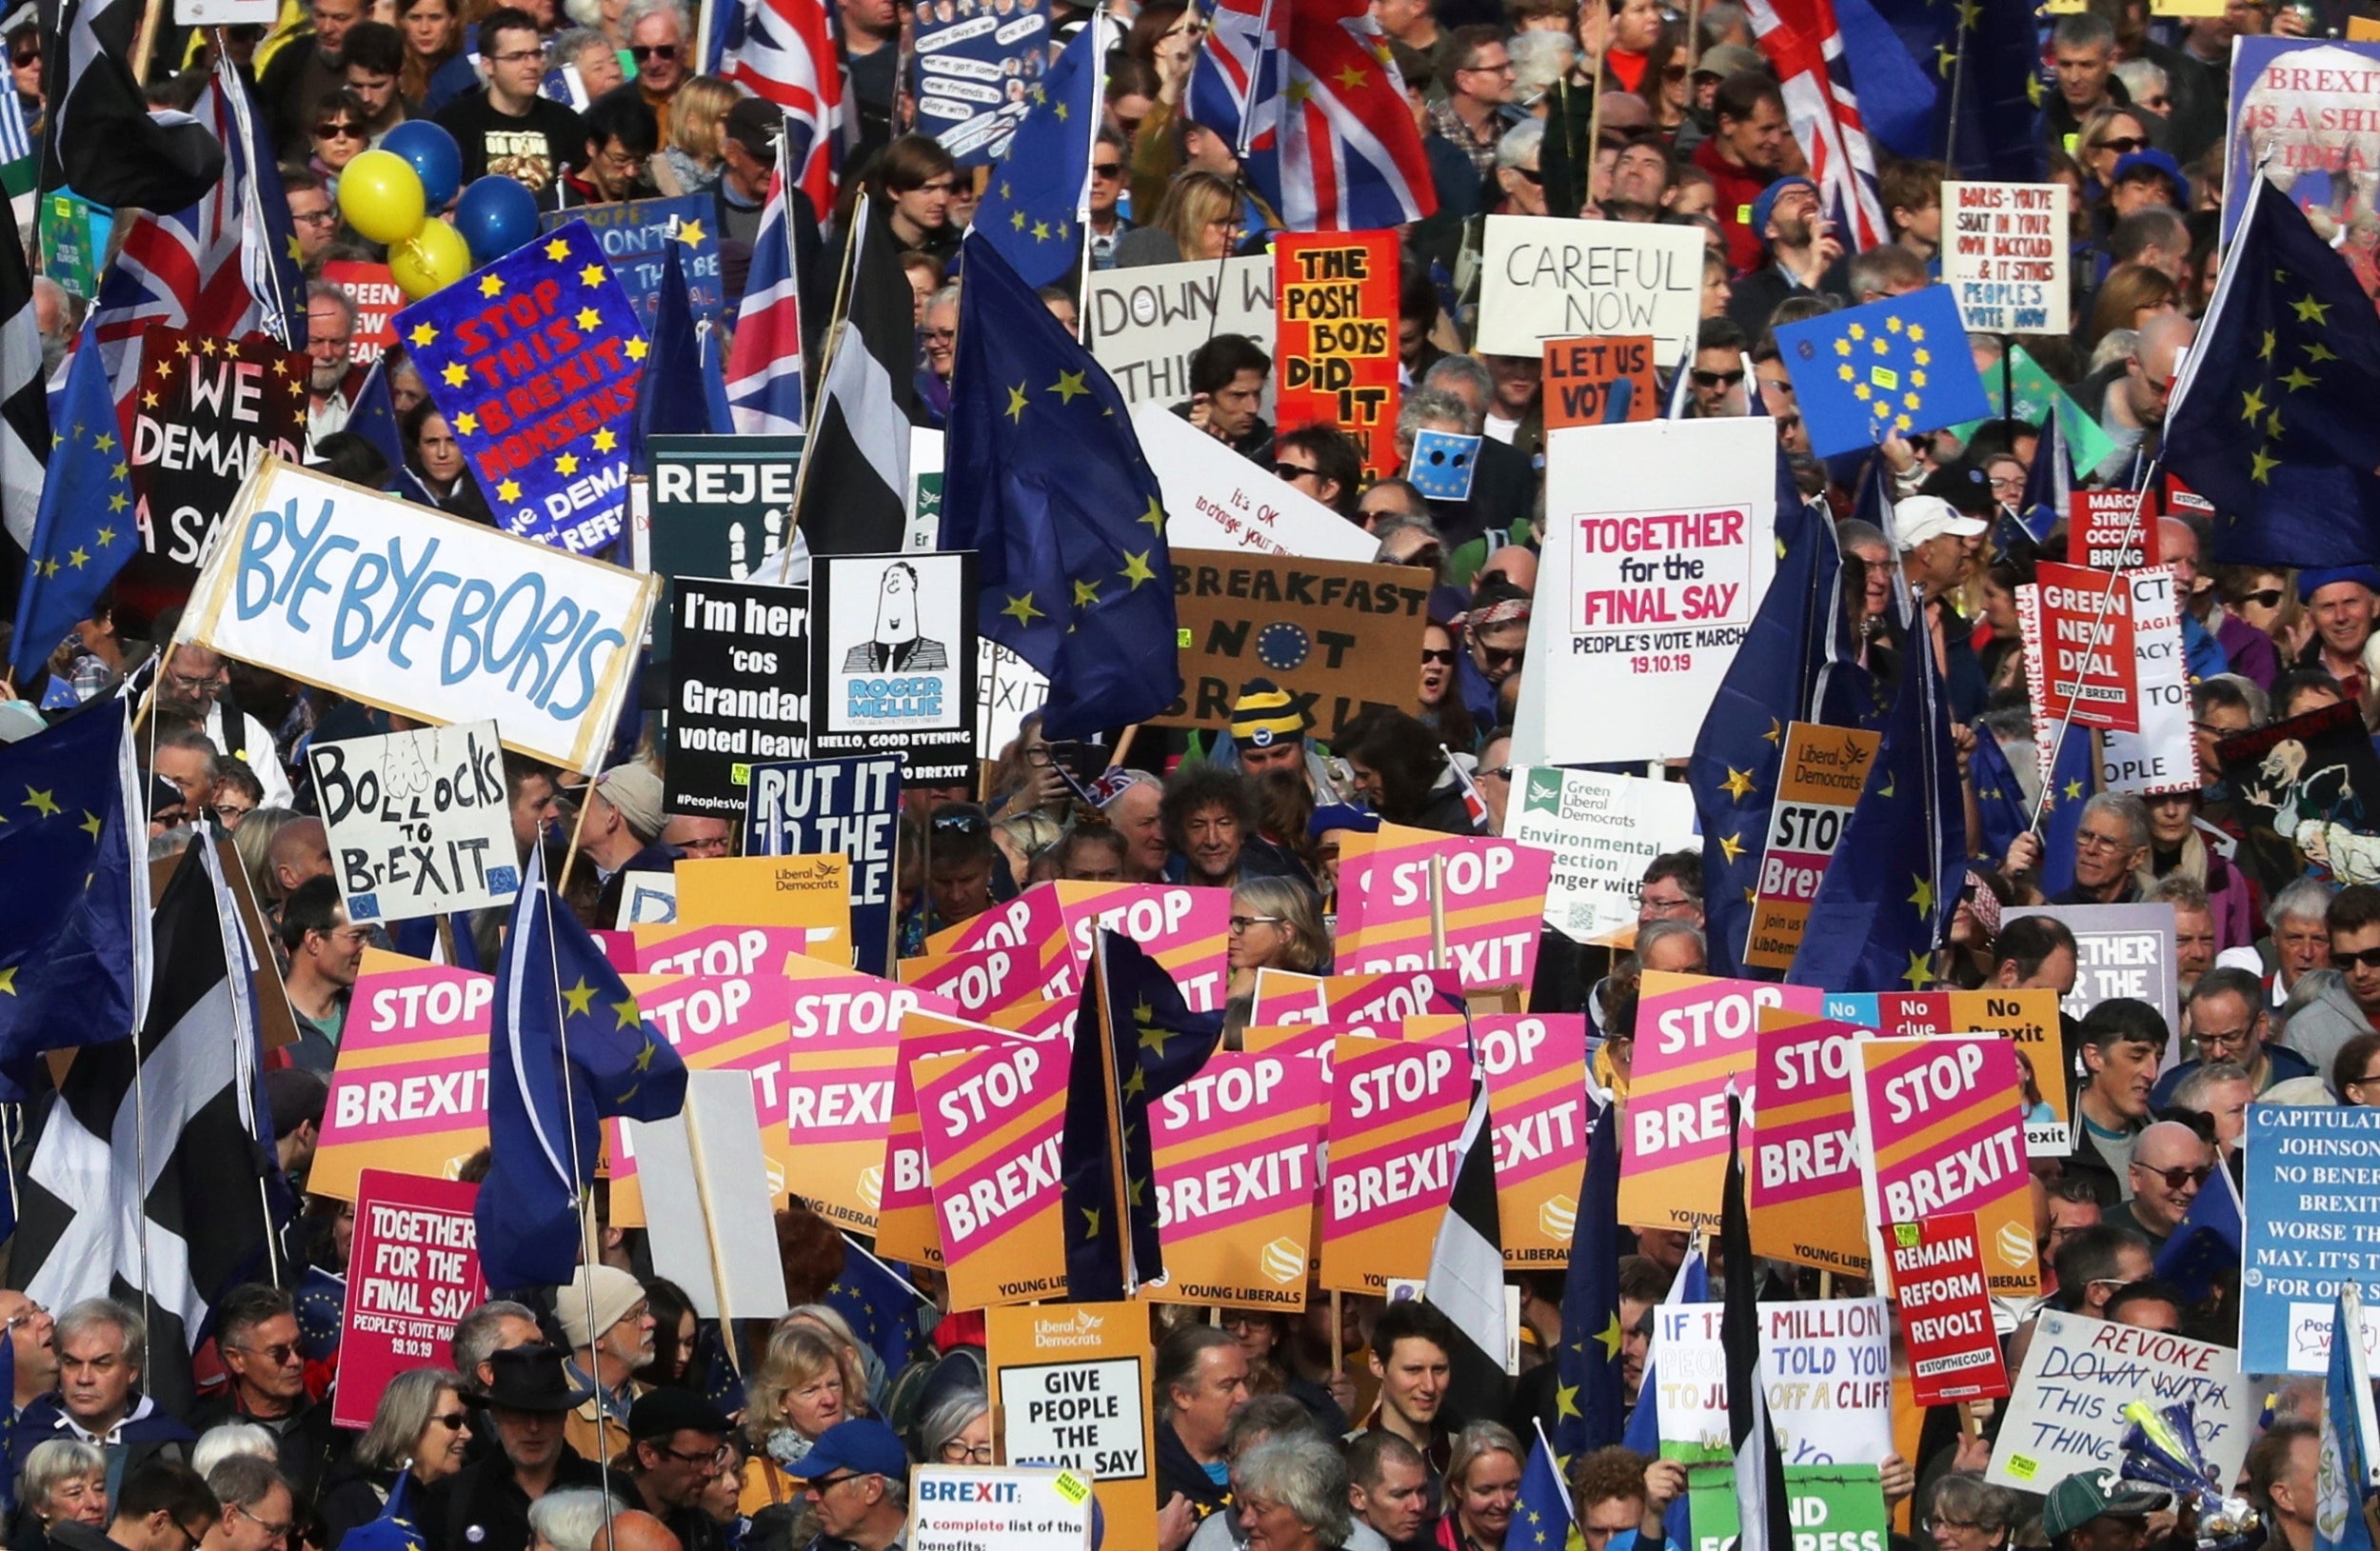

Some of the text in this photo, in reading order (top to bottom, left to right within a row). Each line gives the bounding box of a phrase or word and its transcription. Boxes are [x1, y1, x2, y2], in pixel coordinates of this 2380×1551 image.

[2246, 105, 2309, 129] IS A
[2283, 144, 2368, 171] IDEA
[1956, 212, 2051, 234] SHAT YOUR
[1957, 236, 2053, 257] OWN BACKYARD
[1298, 249, 1367, 280] THE
[1505, 244, 1694, 291] CAREFUL
[343, 283, 400, 305] REEN
[1096, 276, 1218, 337] DOWN
[1286, 284, 1359, 319] POSH
[1963, 283, 2042, 306] PEOPLE'S
[453, 278, 561, 355] STOP
[1564, 291, 1657, 332] NOW
[1964, 307, 2048, 328] VOTE NOW
[472, 317, 582, 388] THIS
[1314, 323, 1387, 354] BOYS
[1550, 343, 1646, 379] LET US
[190, 355, 264, 424] WE
[477, 336, 624, 436] BREXIT
[1339, 388, 1387, 422] IT
[131, 413, 301, 481] DEMAND
[656, 464, 793, 505] REJE
[1229, 487, 1279, 528] It's OK
[2089, 493, 2141, 509] MARCH
[1195, 495, 1273, 551] to change your
[1578, 510, 1745, 555] TOGETHER
[2092, 510, 2141, 527] STRIKE
[2086, 528, 2147, 544] OCCUPY
[1619, 553, 1705, 584] for the
[2091, 547, 2144, 567] BRING
[1173, 566, 1428, 617] BREAKFAST
[1584, 583, 1740, 626] FINAL SAY
[2044, 587, 2126, 616] GREEN
[684, 592, 737, 632] I'm
[1572, 627, 1748, 656] PEOPLE'S VOTE MARCH
[2056, 619, 2115, 646] NEW
[1631, 654, 1692, 674] 19.10.19
[2058, 649, 2118, 677] DEAL
[847, 676, 943, 699] ROGER
[2055, 682, 2125, 702] STOP BREXIT
[2147, 686, 2183, 706] TO
[847, 697, 943, 718] MELLIE
[679, 727, 745, 755] voted
[817, 730, 971, 750] HELLO, GOOD EVENING
[1798, 744, 1838, 764] Liberal
[915, 765, 968, 780] BREXIT
[1795, 766, 1861, 790] Democrats
[757, 761, 896, 819] PUT IT
[1563, 794, 1608, 810] Liberal
[1567, 781, 1611, 798] Green
[1561, 806, 1636, 827] Democrats
[400, 823, 432, 843] TO
[815, 813, 891, 861] THE
[1519, 825, 1661, 857] Environmental
[775, 868, 813, 881] Liberal
[775, 878, 840, 891] Democrats
[1075, 889, 1193, 961] STOP
[2093, 969, 2148, 999] THE
[370, 978, 494, 1032] STOP
[792, 988, 920, 1038] STOP
[1830, 998, 2020, 1017] No No No
[1658, 986, 1783, 1055] STOP
[1896, 1021, 1936, 1035] clue
[939, 1047, 1040, 1137] STOP
[1161, 1059, 1283, 1130] STOP
[1350, 1048, 1451, 1119] STOP
[1885, 1044, 1983, 1123] STOP
[1155, 1143, 1309, 1228] BREXIT
[1884, 1125, 2021, 1223] BREXIT
[2274, 1166, 2307, 1183] NO
[371, 1205, 476, 1250] TOGETHER
[1669, 1209, 1721, 1228] YOUNG
[2268, 1222, 2346, 1241] WORSE
[376, 1243, 466, 1284] FOR THE
[1794, 1243, 1839, 1263] YOUNG
[1894, 1236, 1973, 1272] REMAIN
[2257, 1249, 2360, 1269] MAY. IT'S
[362, 1281, 471, 1321] FINAL SAY
[999, 1278, 1050, 1296] YOUNG
[1180, 1282, 1301, 1304] YOUNG LIBERALS
[1899, 1272, 1982, 1309] REFORM
[2266, 1279, 2311, 1296] FOR
[353, 1314, 407, 1337] PEOPLE'S
[408, 1322, 435, 1338] VOTE
[1034, 1318, 1074, 1334] Liberal
[1664, 1305, 1882, 1341] IF MILLION
[1911, 1309, 1983, 1344] REVOLT
[391, 1338, 432, 1358] 19.10.19
[1034, 1331, 1101, 1347] Democrats
[2092, 1324, 2220, 1372] REVOKE
[1772, 1345, 1887, 1375] TOLD YOU
[1919, 1350, 1993, 1374] #STOPTHECOUP
[2040, 1346, 2149, 1388] DOWN
[1044, 1369, 1101, 1393] GIVE
[1029, 1396, 1119, 1422] PEOPLE
[1661, 1381, 1891, 1410] TO OFF A CLIFF
[2037, 1385, 2106, 1419] THIS
[1053, 1425, 1099, 1448] THE
[2033, 1422, 2114, 1461] THING
[2193, 1420, 2229, 1442] OF
[1095, 1449, 1139, 1474] SAY
[918, 1518, 1082, 1534] A complete list of the
